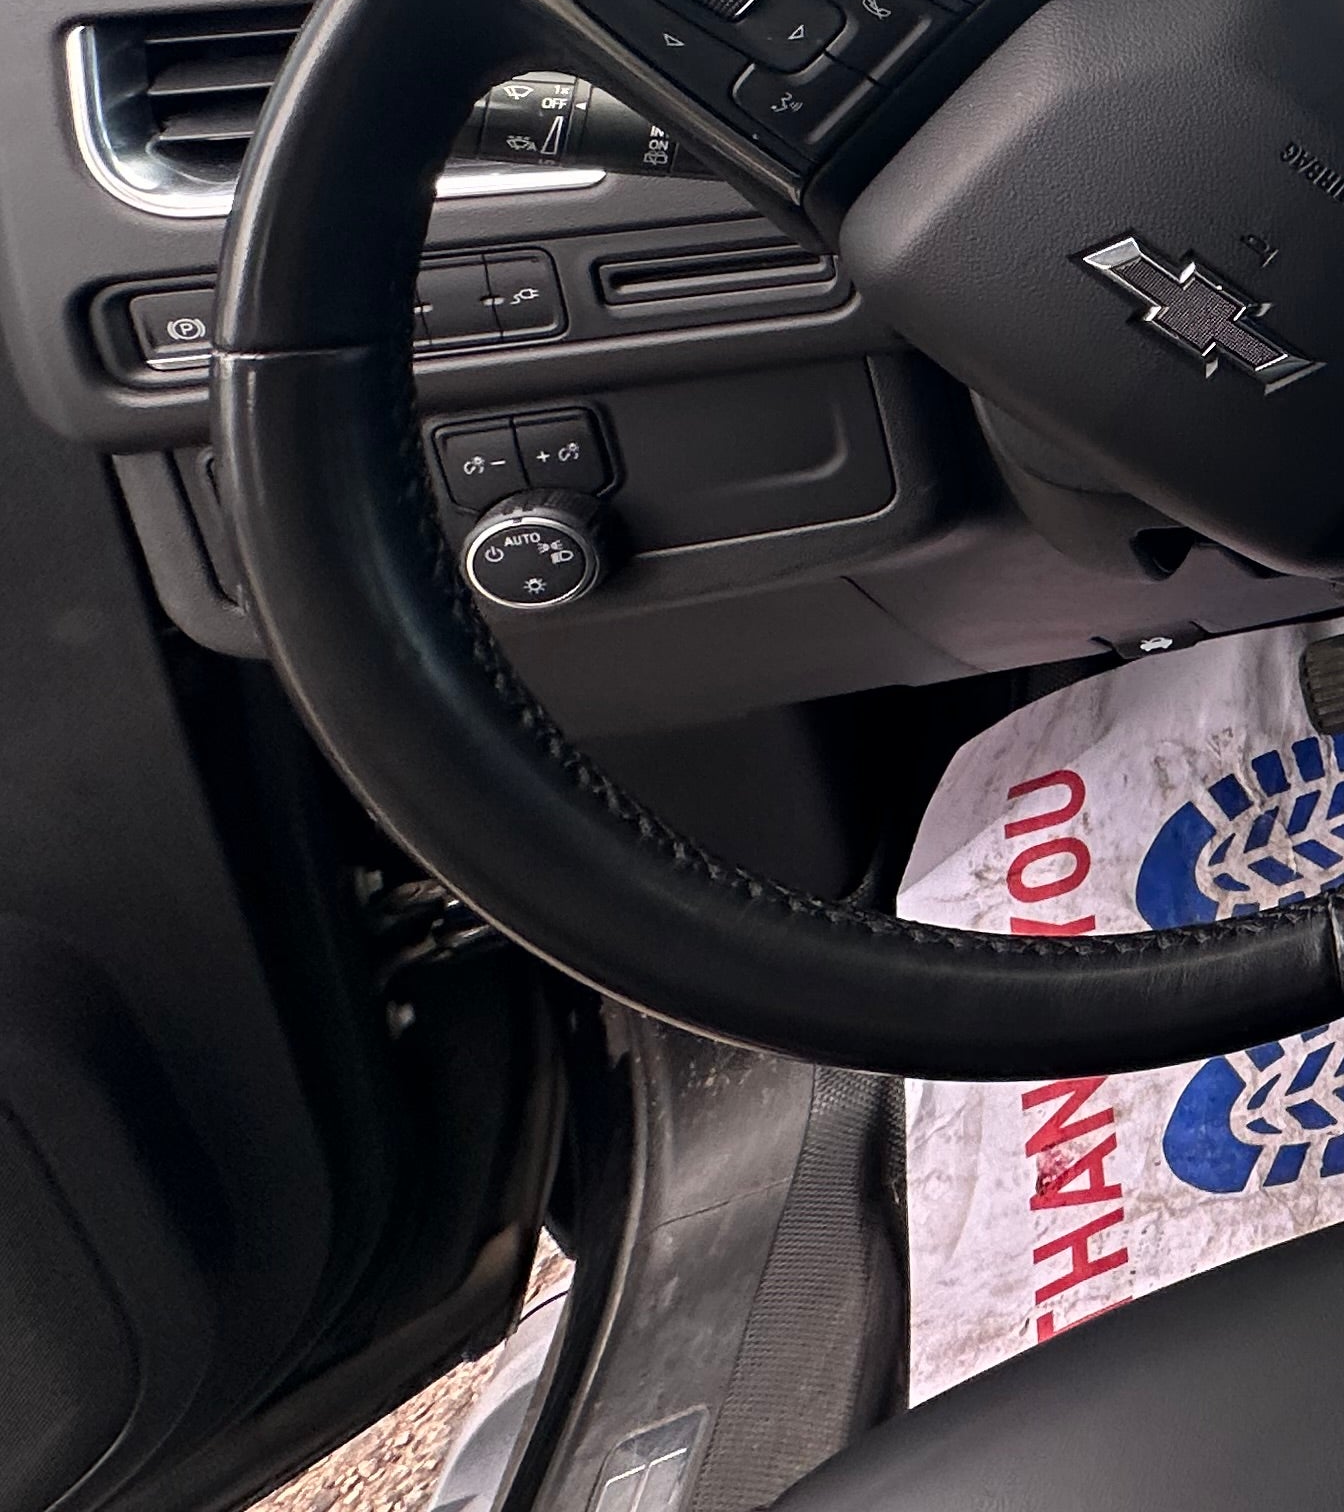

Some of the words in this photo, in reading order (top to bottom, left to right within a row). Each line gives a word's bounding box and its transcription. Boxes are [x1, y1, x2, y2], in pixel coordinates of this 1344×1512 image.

[541, 97, 568, 110] OFF
[649, 139, 669, 151] ON
[504, 531, 541, 548] AUTO
[1021, 1076, 1134, 1345] HAN
